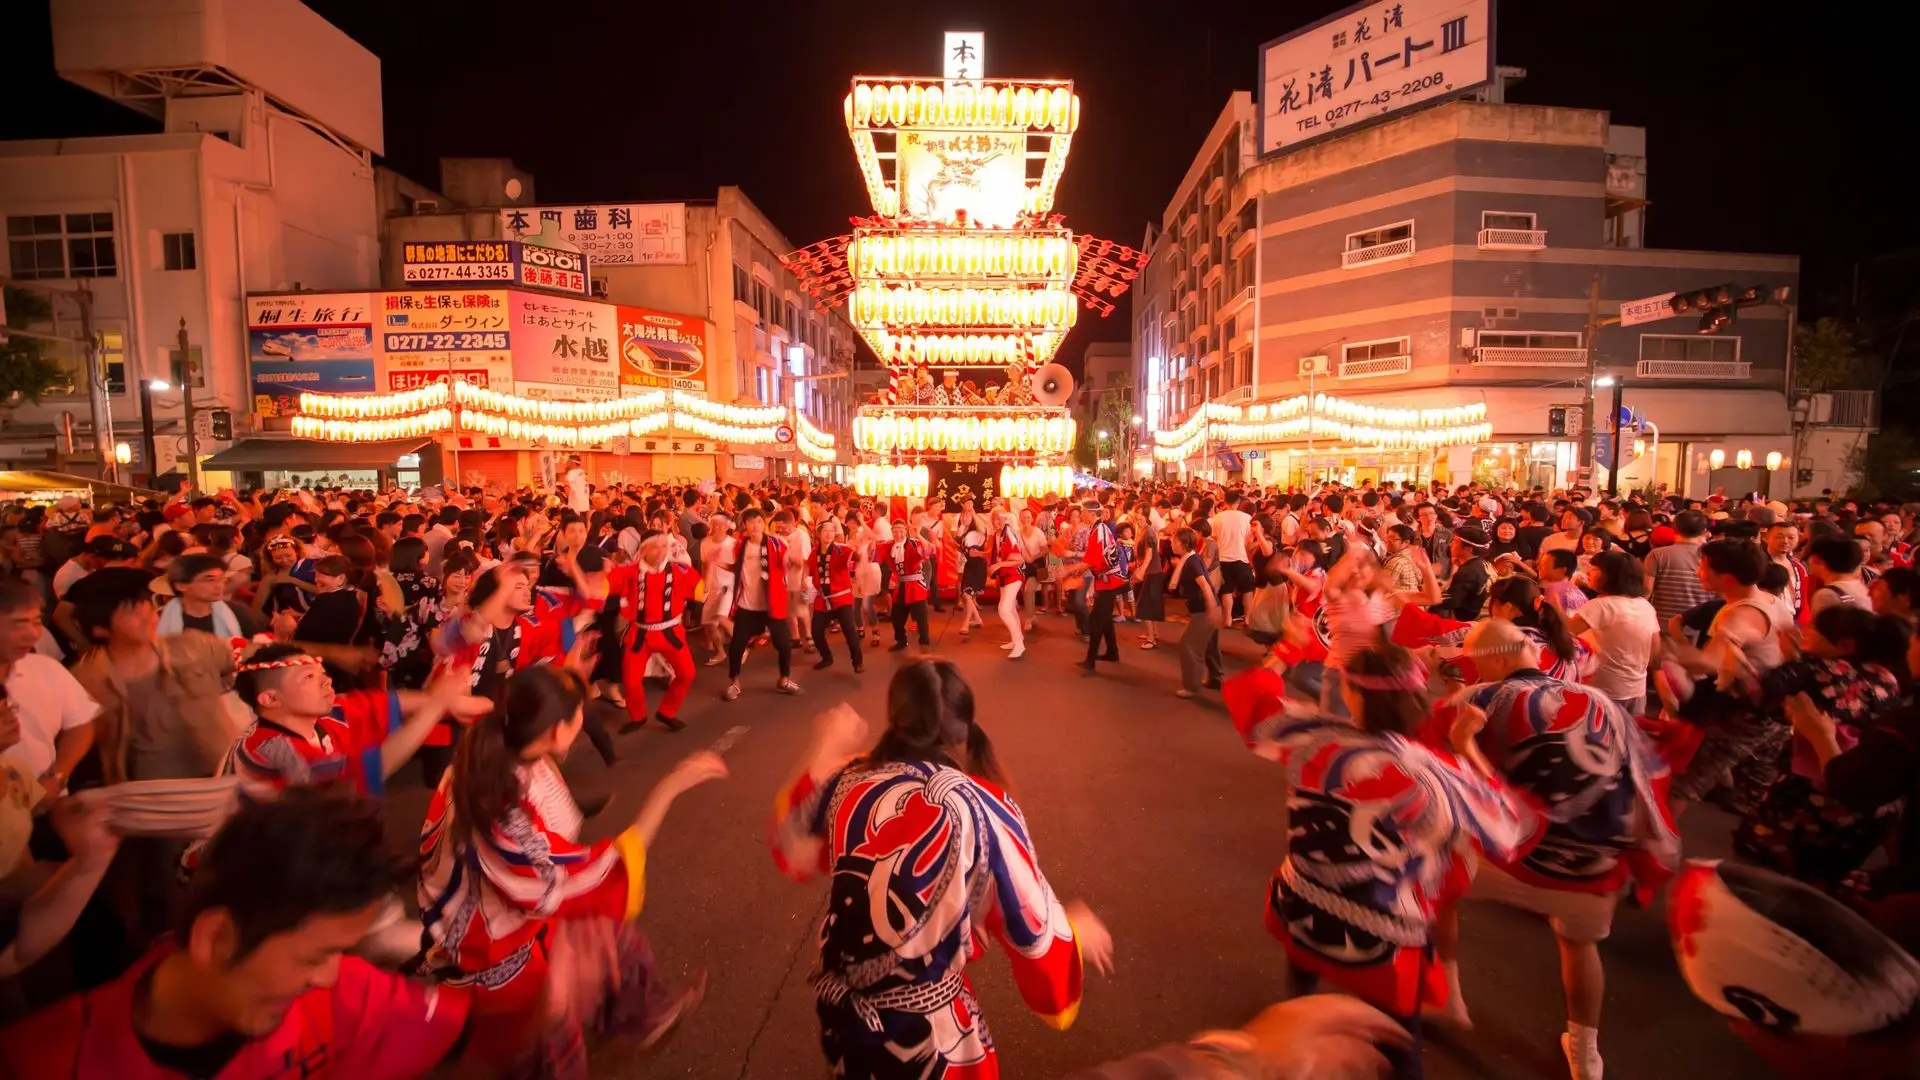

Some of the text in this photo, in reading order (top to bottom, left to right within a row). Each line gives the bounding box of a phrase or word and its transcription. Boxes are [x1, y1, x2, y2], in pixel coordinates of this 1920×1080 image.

[1296, 72, 1444, 132] TEL 0277-43-2208
[522, 249, 582, 271] GOTOH
[419, 266, 509, 279] 0277-44-3345
[524, 266, 583, 290] 後藤酒店
[385, 295, 500, 310] 損保も生保も保険は
[523, 302, 594, 318] セレモニーホール
[258, 307, 364, 324] 桐生旅行
[440, 315, 504, 329] ダーウィン
[523, 314, 597, 332] はあとサイト
[387, 333, 506, 350] 0277-22-2345
[622, 322, 703, 345] 太陽光発電システム
[552, 334, 609, 362] 水越
[674, 380, 693, 388] 1400
[953, 463, 978, 474] 上州
